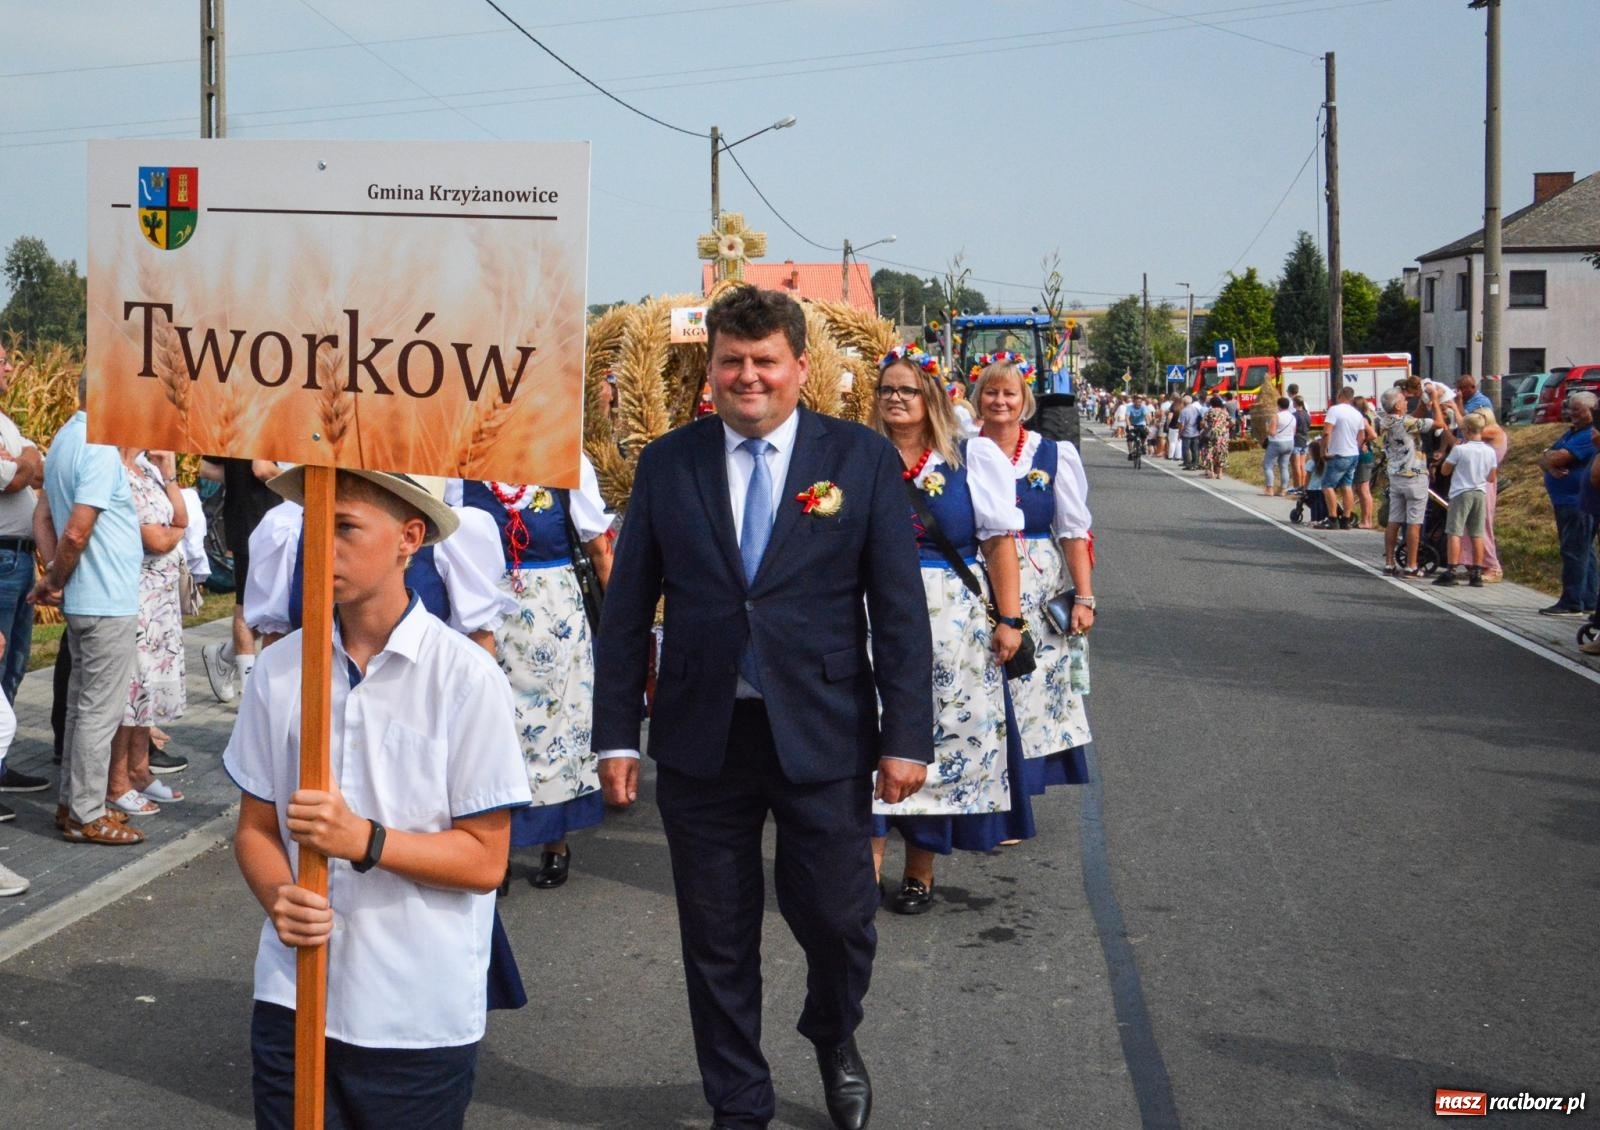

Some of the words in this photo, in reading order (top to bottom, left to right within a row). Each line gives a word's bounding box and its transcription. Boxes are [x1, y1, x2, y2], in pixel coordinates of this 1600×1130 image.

[367, 184, 424, 201] Gmina
[430, 185, 559, 206] Krzyżanowice
[123, 301, 536, 404] Tworków
[1219, 344, 1229, 358] P
